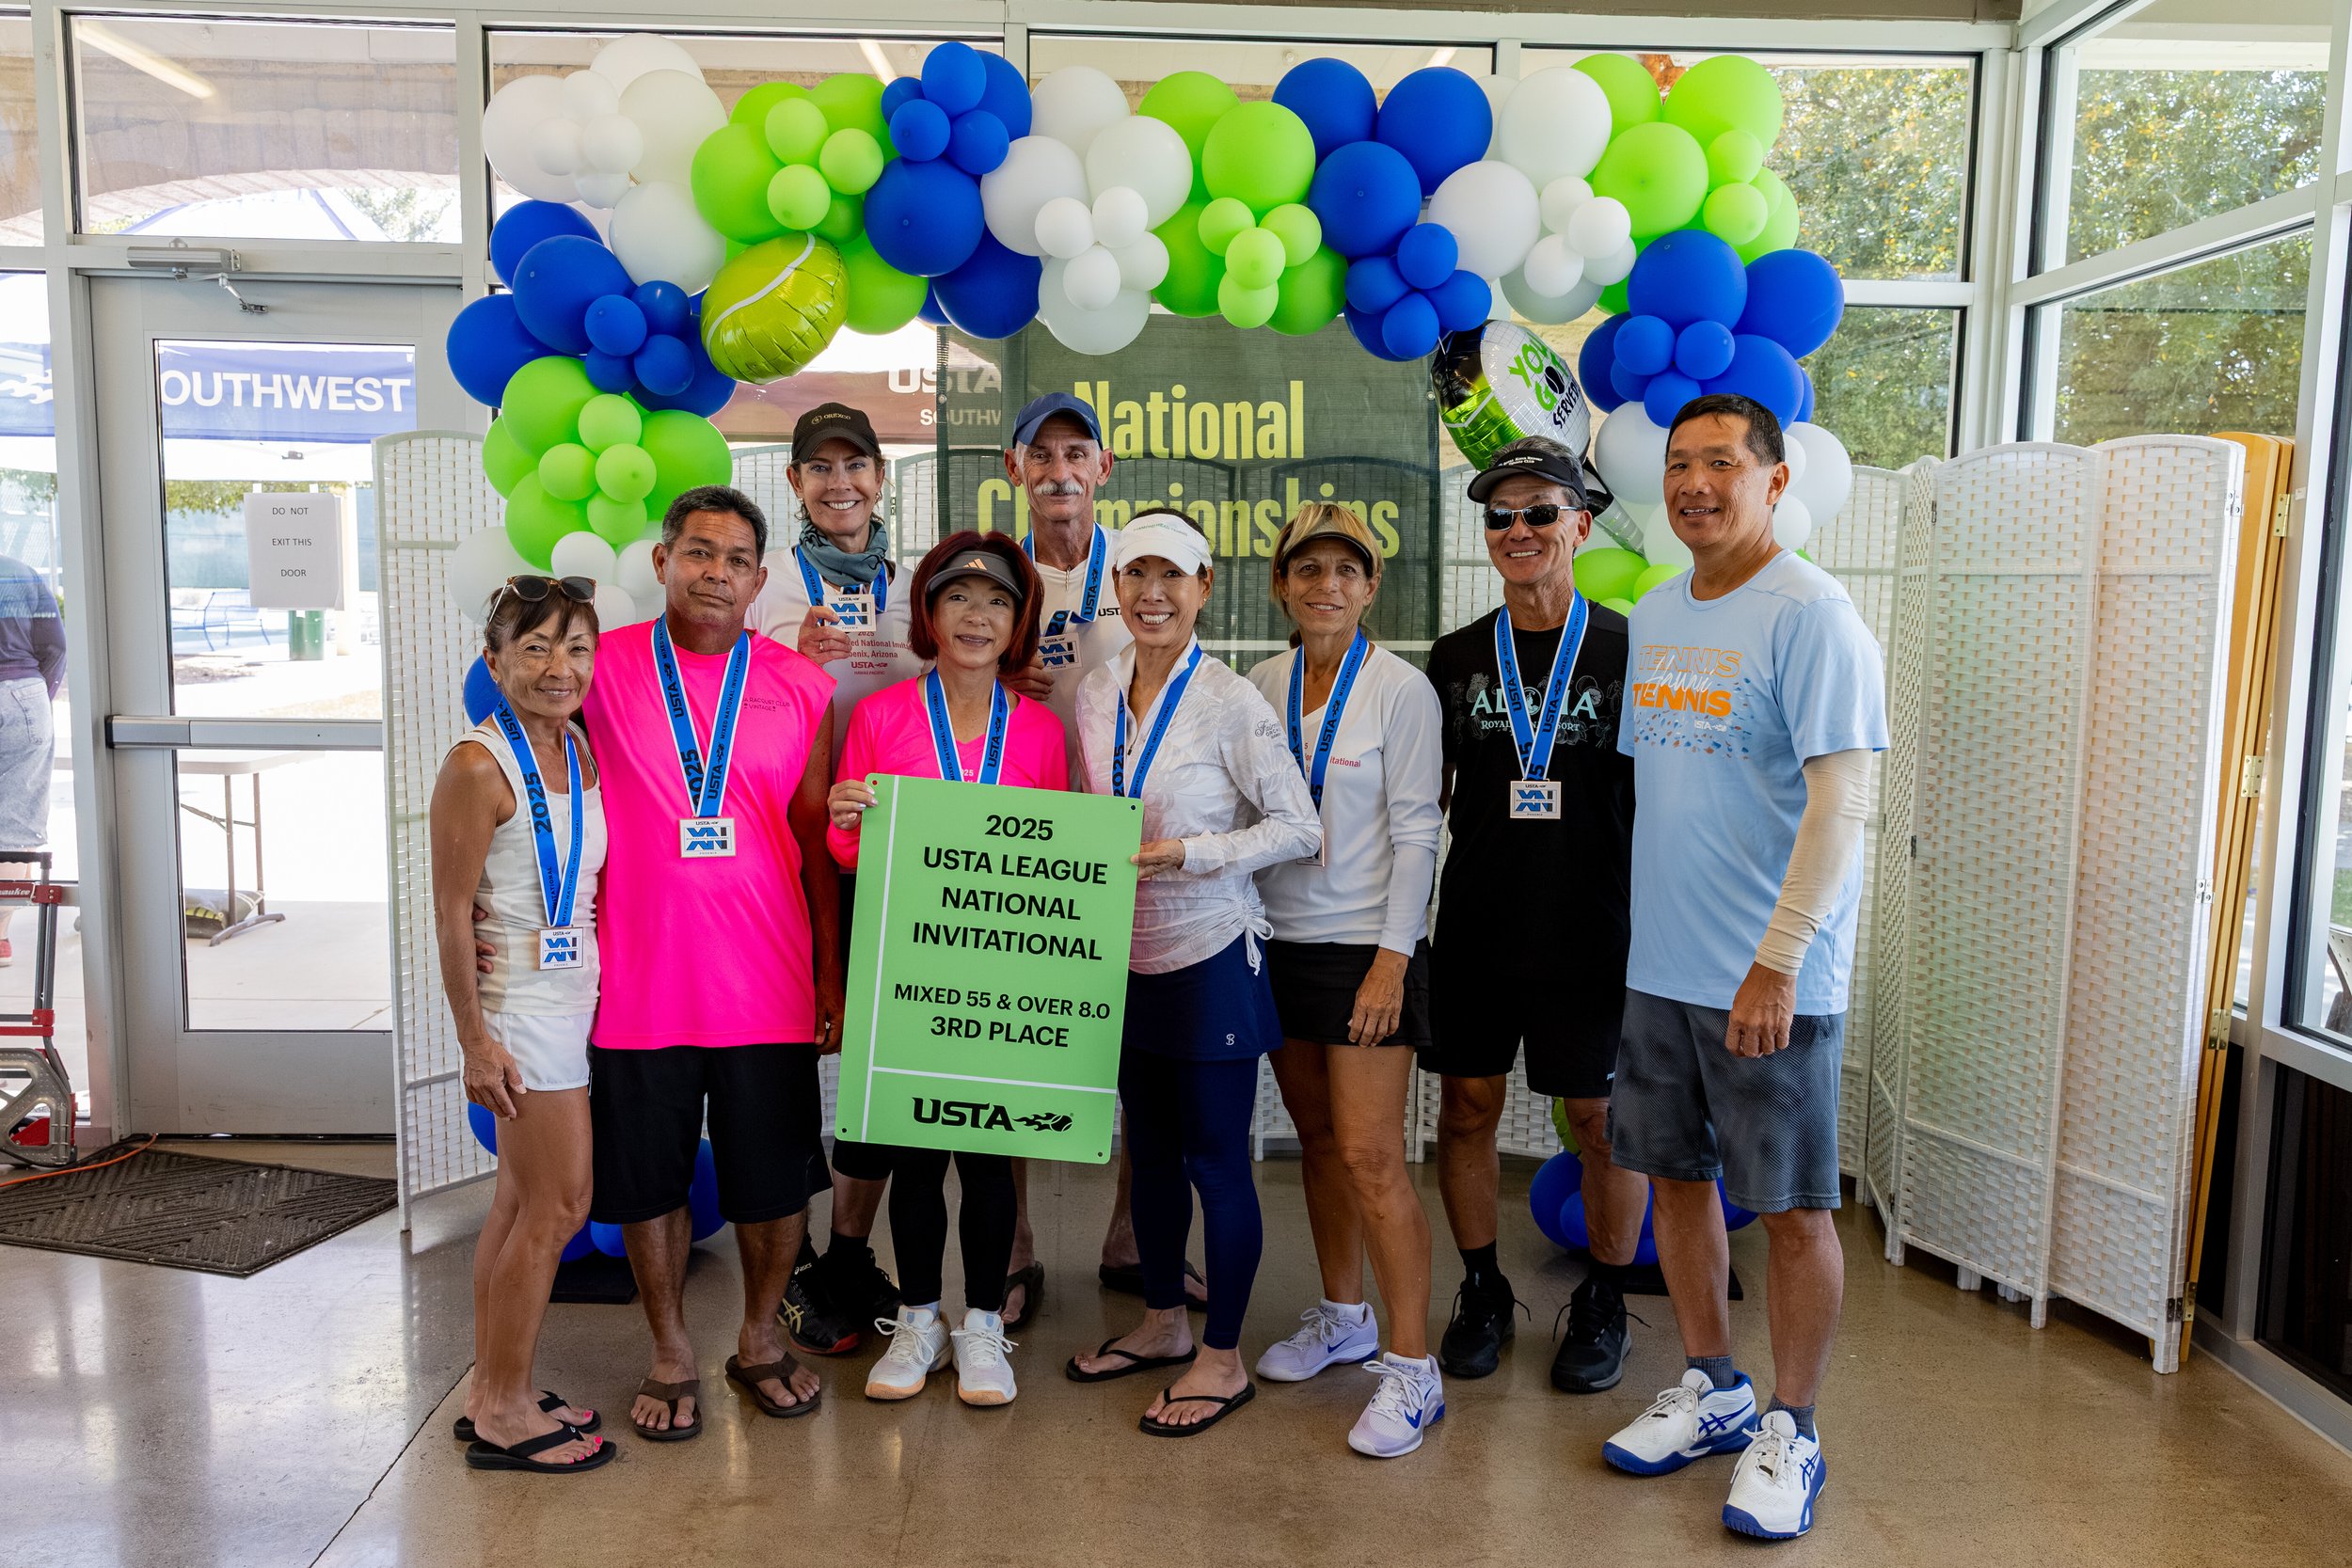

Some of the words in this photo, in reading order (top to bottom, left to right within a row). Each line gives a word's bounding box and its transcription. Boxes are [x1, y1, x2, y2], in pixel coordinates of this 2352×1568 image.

[1508, 332, 1548, 388] YOU
[272, 507, 285, 515] DO
[291, 507, 309, 515] NOT
[1084, 585, 1098, 616] USTA
[1098, 607, 1121, 617] UST
[871, 650, 898, 658] Arizona
[1638, 644, 1742, 678] TENNIS
[1338, 679, 1348, 696] MIXED
[1344, 652, 1359, 679] NATIONAL
[667, 682, 684, 719] USTA
[723, 689, 736, 718] NATIONAL
[1507, 677, 1522, 712] USTA
[1632, 683, 1732, 718] TENNIS
[500, 708, 521, 741] USTA
[1542, 699, 1560, 733] USTA
[1557, 723, 1581, 732] SORT
[941, 731, 950, 760] NATIONAL
[988, 735, 1001, 768] USTA
[1133, 775, 1141, 795] MIXED
[1139, 745, 1153, 775] NATIONAL
[1152, 703, 1172, 744] INVITATIONAL
[1319, 719, 1337, 752] USTA
[1330, 756, 1361, 768] itational
[707, 765, 723, 800] USTA
[523, 771, 552, 833] 2025
[985, 814, 1054, 841] 2025
[566, 866, 576, 896] NATIONAL
[922, 847, 993, 874] USTA
[1001, 854, 1108, 885] LEAGUE
[941, 886, 1081, 920] NATIONAL
[913, 922, 1103, 960] INVITATIONAL
[894, 983, 961, 1006] MIXED
[966, 990, 992, 1008] 55
[996, 993, 1011, 1010] &
[1017, 995, 1073, 1017] OVER
[1078, 1001, 1111, 1020] 8.0
[930, 1016, 982, 1039] 3RD
[988, 1022, 1070, 1048] PLACE
[911, 1097, 1016, 1132] USTA
